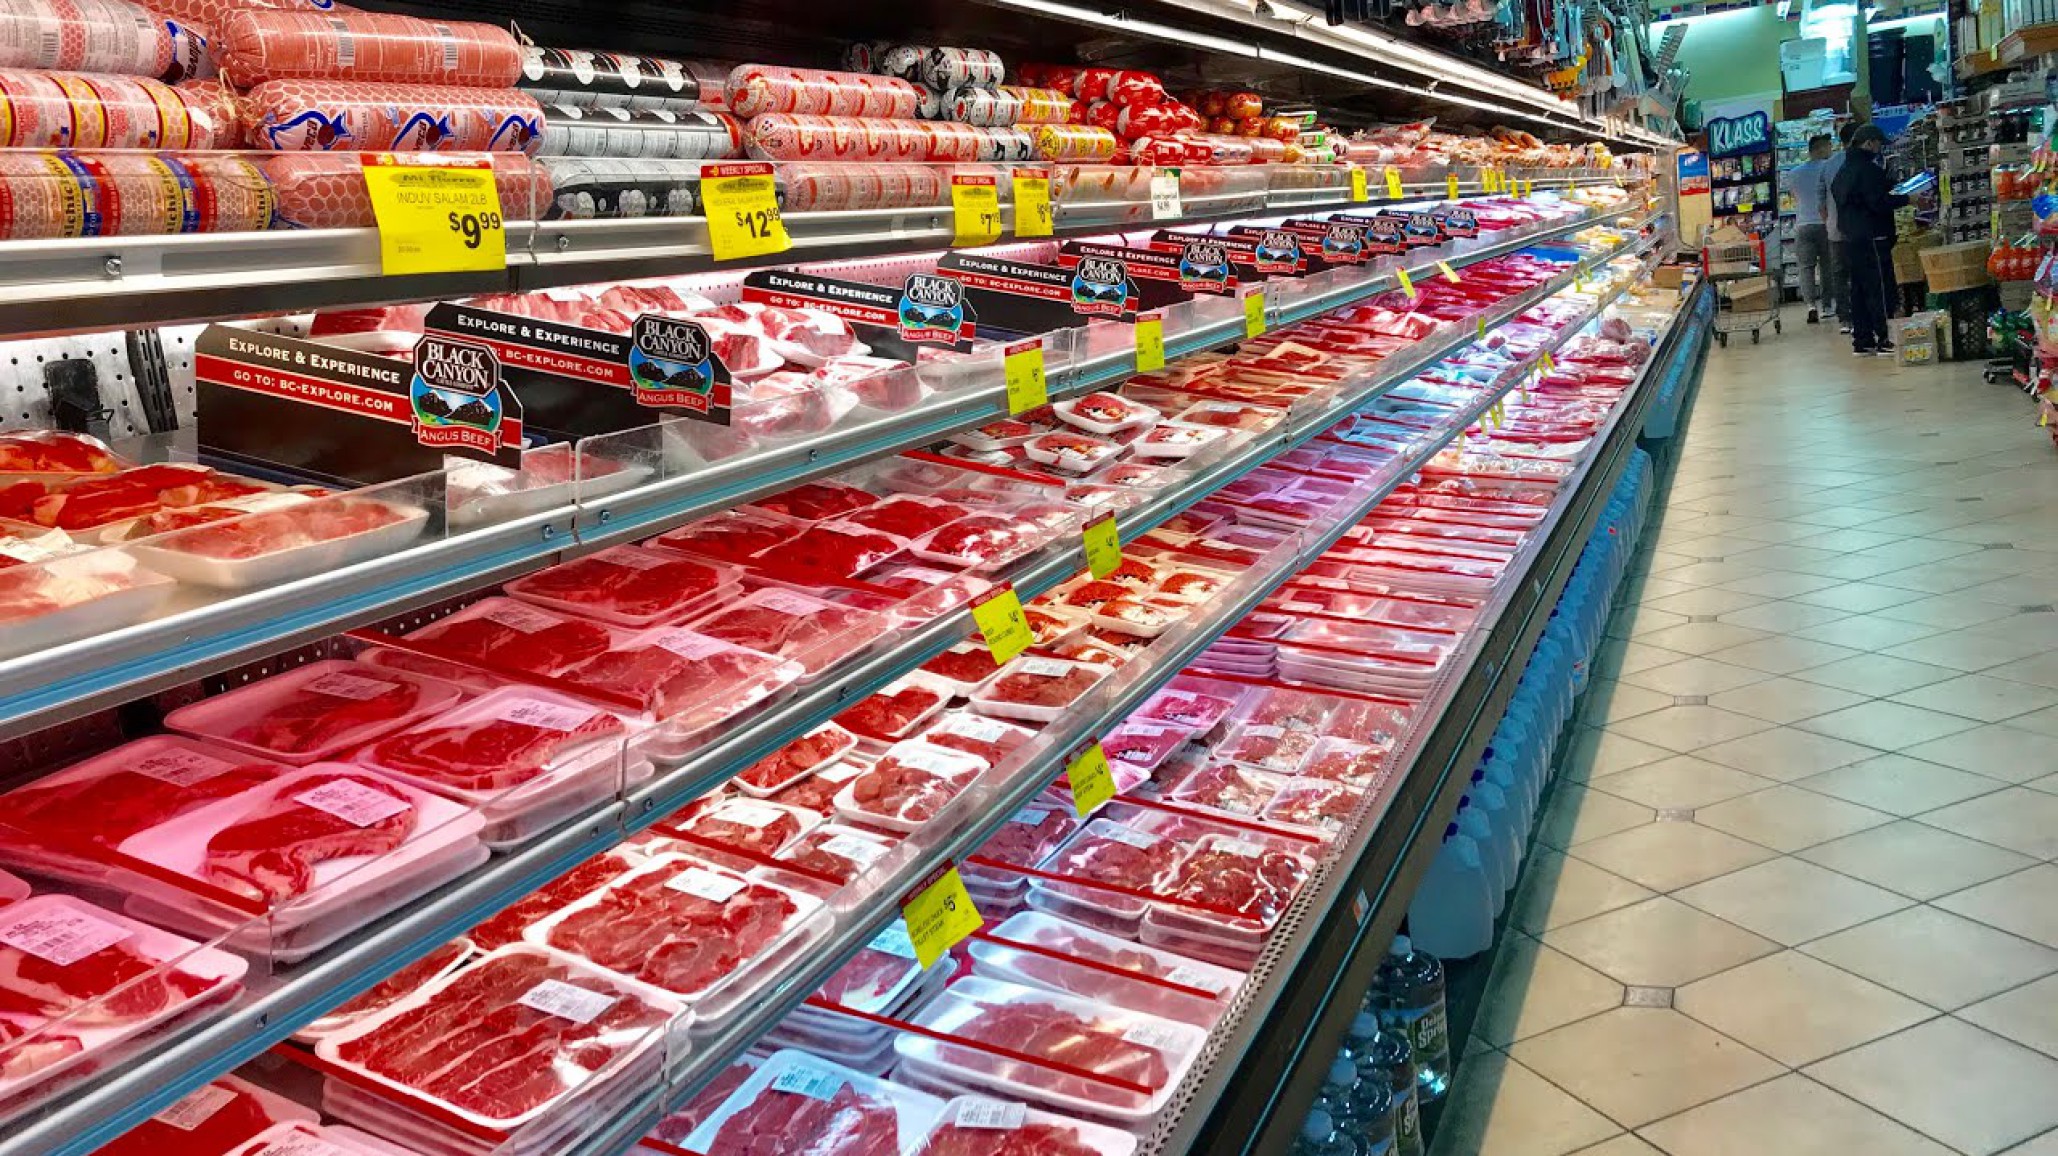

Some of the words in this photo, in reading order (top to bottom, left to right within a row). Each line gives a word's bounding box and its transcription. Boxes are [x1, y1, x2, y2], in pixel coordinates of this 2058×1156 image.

[1711, 115, 1761, 152] KLASS
[1168, 234, 1199, 243] EXPLORE
[1080, 246, 1115, 257] EXPLORE
[1125, 252, 1175, 265] EXPERIENCE
[1084, 259, 1120, 274] BLACK
[959, 258, 998, 271] EXPLORE
[1001, 265, 1008, 273] &
[1010, 266, 1067, 283] EXPERIENCE
[1081, 268, 1122, 284] CANYON
[769, 275, 815, 292] EXPLORE
[817, 283, 825, 293] &
[828, 284, 893, 304] EXPERIENCE
[909, 287, 956, 305] CANYON
[914, 277, 953, 293] BLACK
[770, 295, 782, 304] GO
[803, 300, 886, 321] BC-EXPLORE.COM
[457, 314, 517, 336] EXPLORE
[520, 326, 531, 338] &
[534, 328, 620, 355] EXPERIENCE
[645, 319, 698, 344] BLACK
[427, 342, 485, 370] BLACK
[640, 333, 701, 360] CANYON
[229, 337, 290, 362] EXPLORE
[295, 350, 306, 365] &
[311, 353, 400, 385] EXPERIENCE
[505, 349, 614, 378] BC-EXPLORE.COM
[422, 360, 489, 389] CANYON
[234, 369, 250, 382] GO
[254, 373, 276, 388] TO:
[279, 379, 394, 413] BC-EXPLORE.COM
[638, 391, 675, 404] ANGUS
[676, 392, 704, 407] BEEF
[420, 429, 459, 442] ANGUS
[461, 430, 492, 445] BEEF
